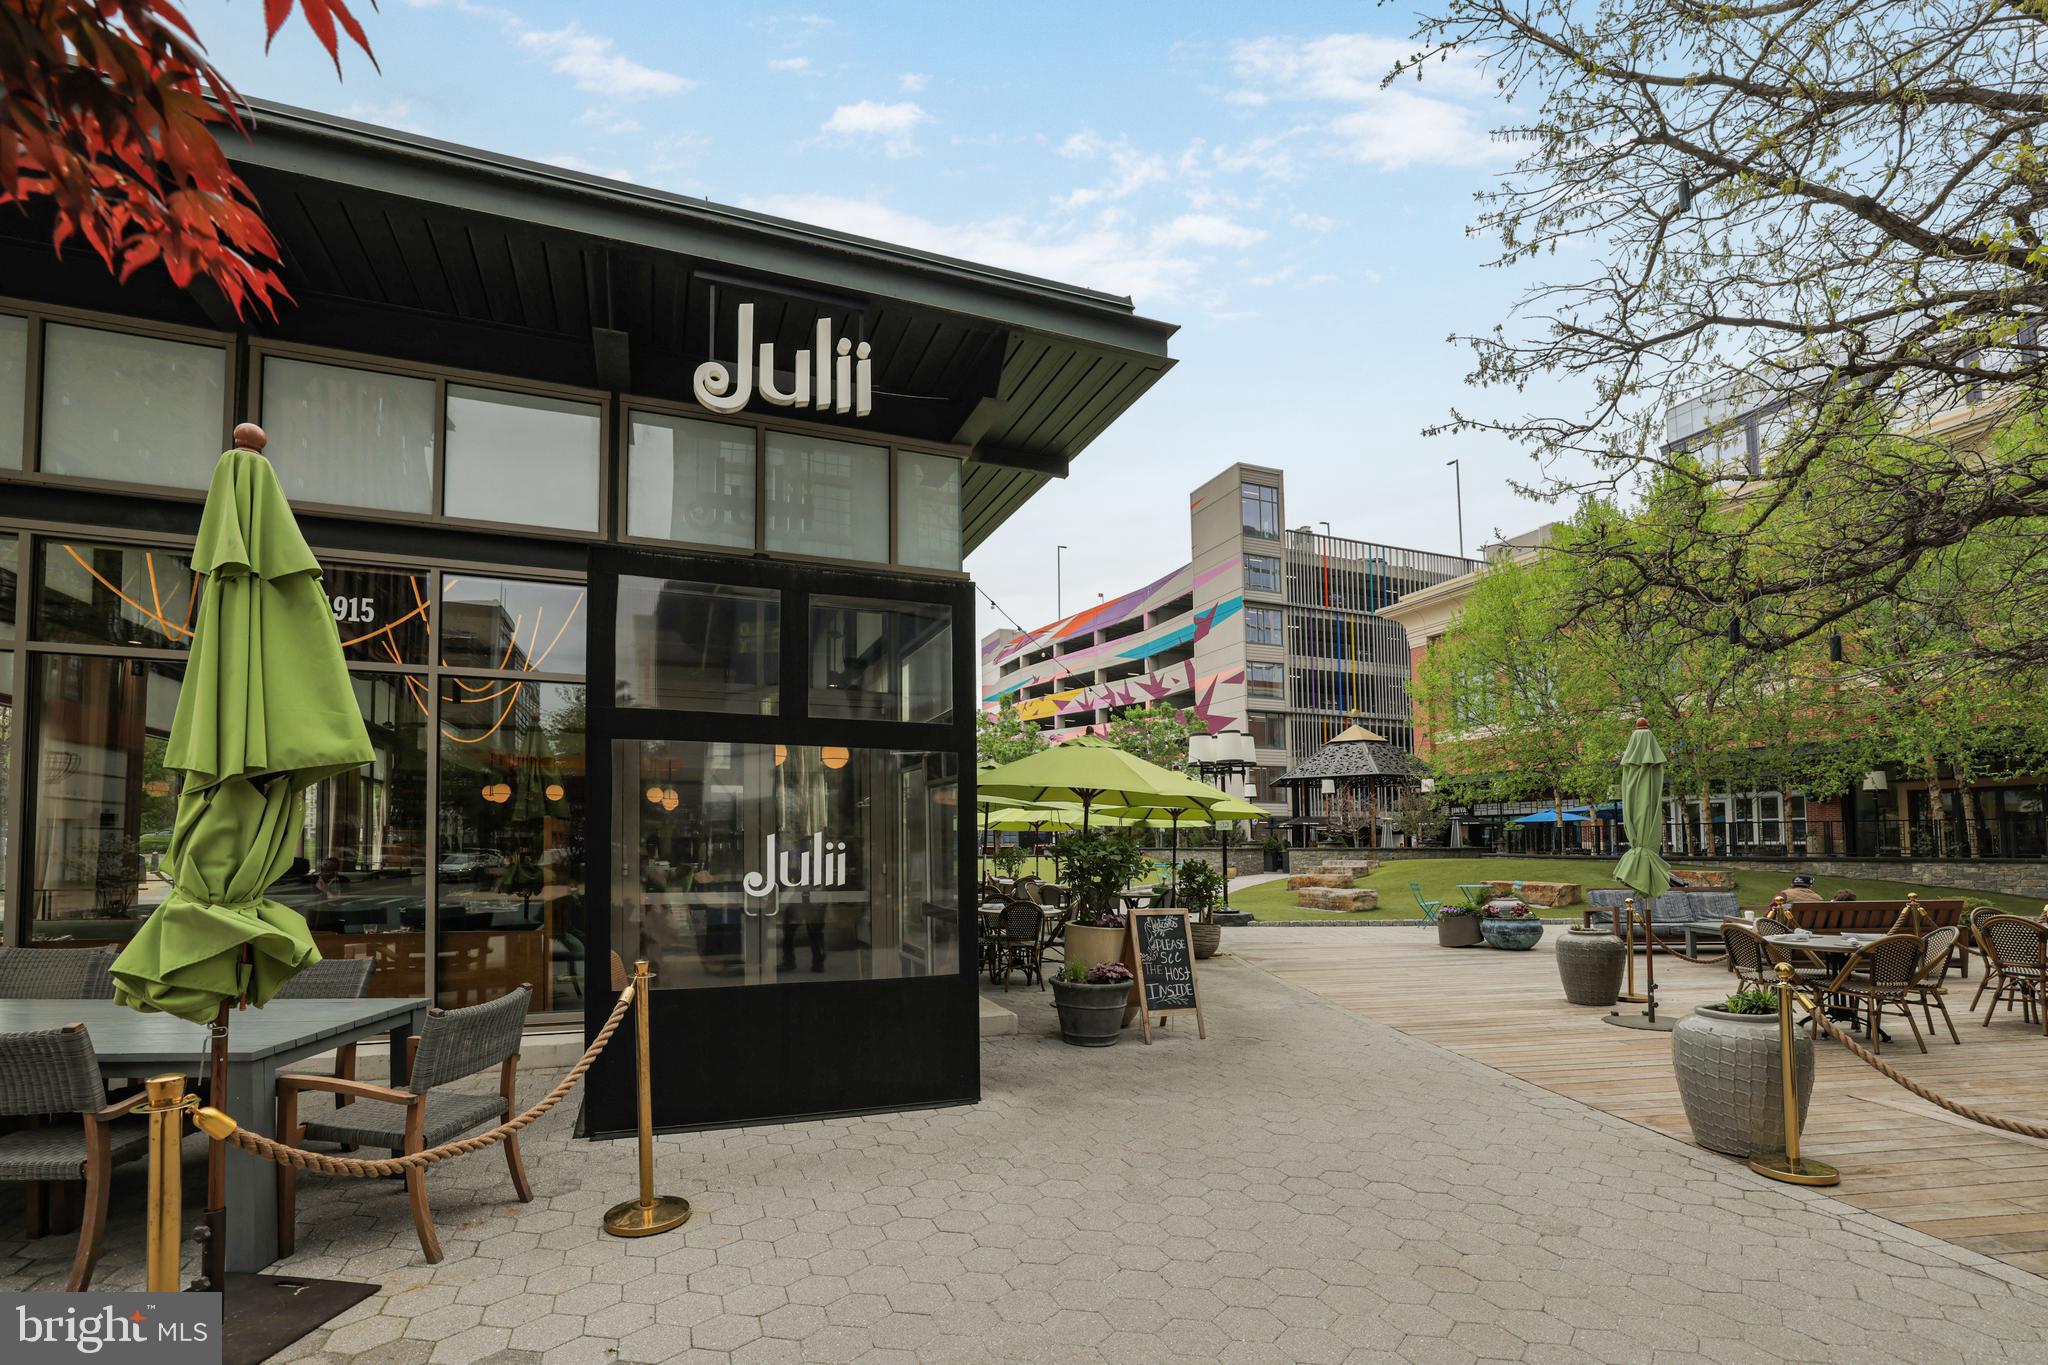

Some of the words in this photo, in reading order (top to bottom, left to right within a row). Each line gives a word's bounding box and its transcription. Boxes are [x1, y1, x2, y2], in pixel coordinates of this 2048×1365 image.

[693, 303, 871, 417] Julii
[326, 595, 375, 623] 915
[743, 831, 846, 897] Julii
[1155, 938, 1186, 952] PLEASE
[1143, 962, 1163, 975] THE
[1146, 982, 1194, 1000] INSIDE
